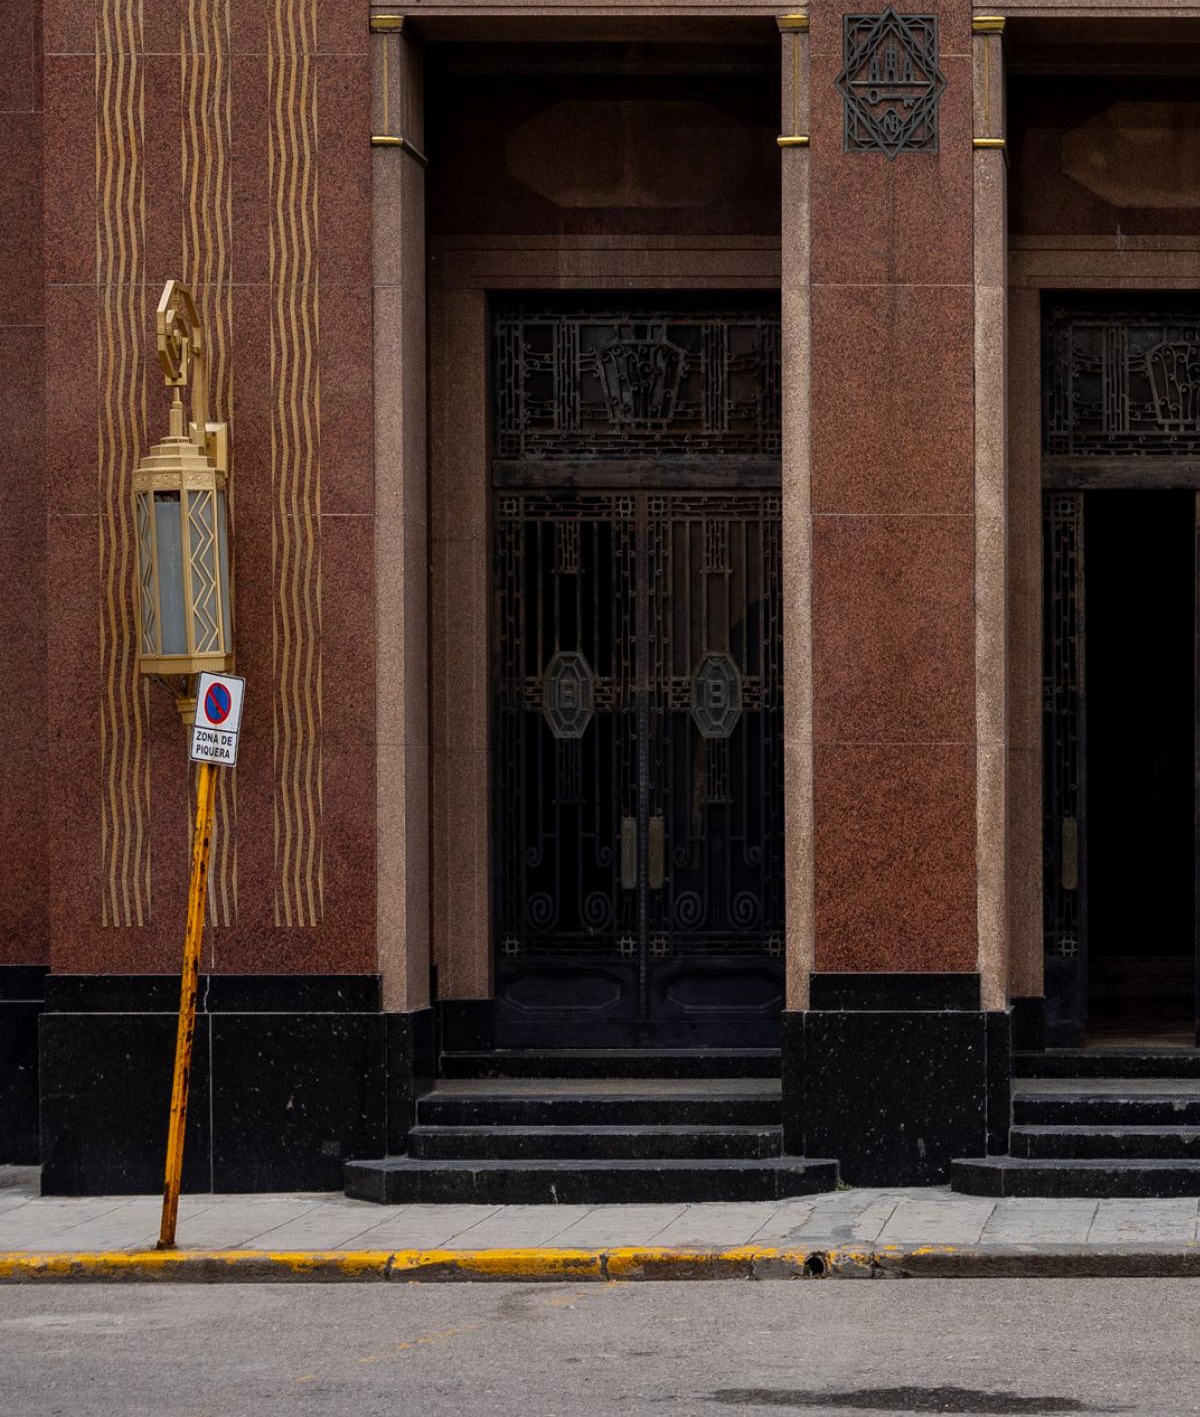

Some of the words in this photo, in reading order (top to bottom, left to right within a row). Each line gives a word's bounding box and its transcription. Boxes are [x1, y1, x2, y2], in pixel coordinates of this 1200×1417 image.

[708, 679, 726, 707] B
[196, 731, 218, 744] ZONA
[221, 735, 233, 746] DE
[196, 744, 230, 758] PIQUERA
